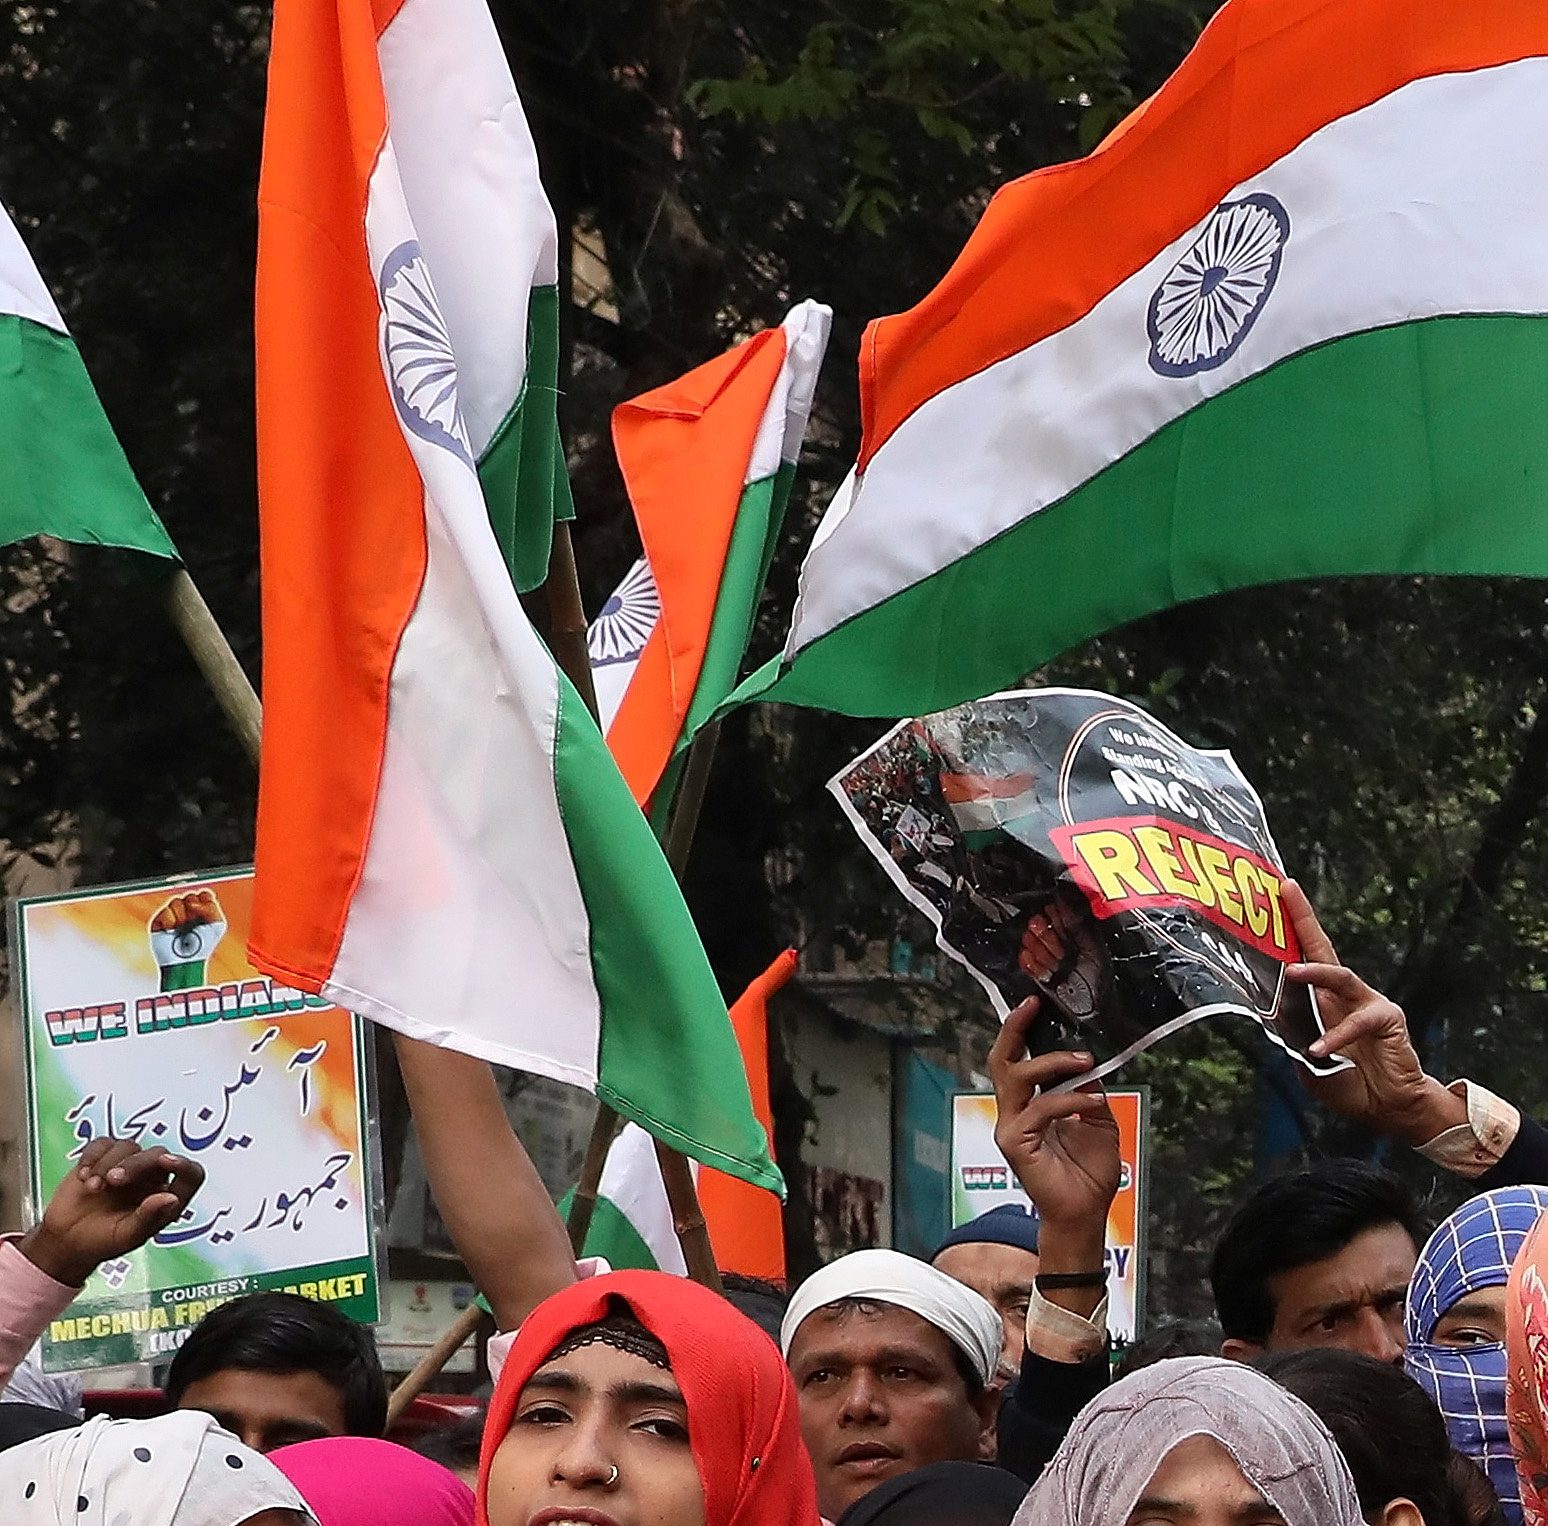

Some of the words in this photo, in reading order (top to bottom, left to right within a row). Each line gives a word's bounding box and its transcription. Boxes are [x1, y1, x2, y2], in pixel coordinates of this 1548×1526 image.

[1110, 769, 1198, 819] NRC
[1072, 826, 1286, 949] REJECT
[46, 1003, 127, 1045] WE
[961, 1167, 1007, 1189] WE
[162, 1279, 247, 1304] COURTESY
[51, 1307, 169, 1343] MECHUA
